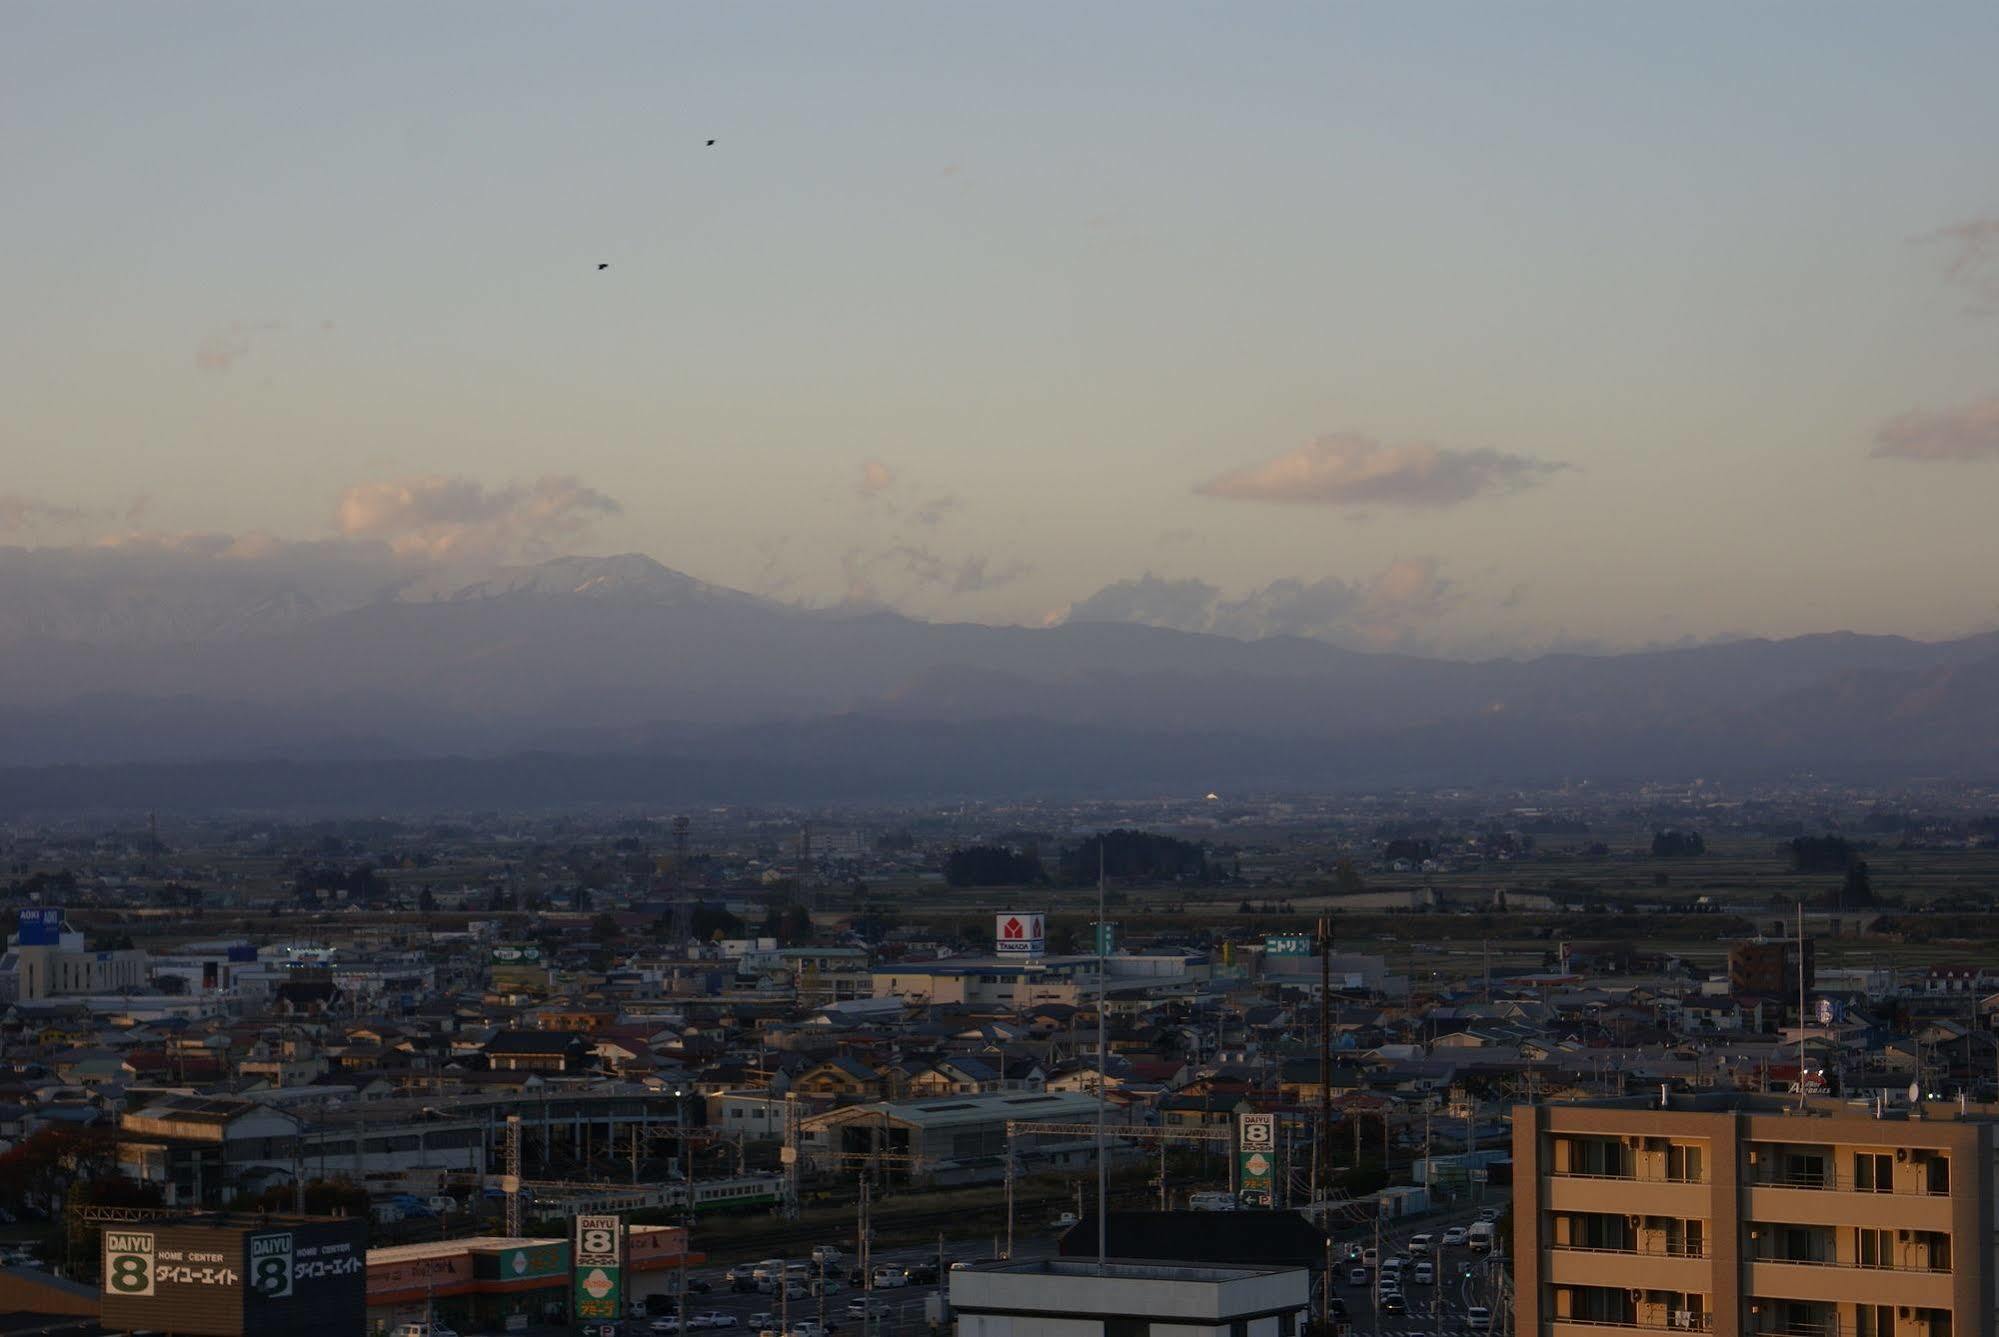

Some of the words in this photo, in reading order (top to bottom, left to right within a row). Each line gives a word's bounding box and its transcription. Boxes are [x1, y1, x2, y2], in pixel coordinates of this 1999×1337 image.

[20, 909, 40, 920] AOKI
[1266, 940, 1297, 953] ニトリ
[1245, 1116, 1270, 1124] DAIYU
[1246, 1124, 1269, 1143] 8
[582, 1219, 614, 1229] DAIYU
[108, 1235, 152, 1252] DAIYU
[253, 1236, 290, 1257] DAIYU
[583, 1230, 613, 1254] 8
[158, 1251, 183, 1261] HOME
[188, 1253, 224, 1263] CENTER
[111, 1255, 149, 1292] 8
[156, 1265, 239, 1286] ダイユーエイト
[255, 1257, 288, 1297] 8
[294, 1256, 364, 1280] ダイユーエイト
